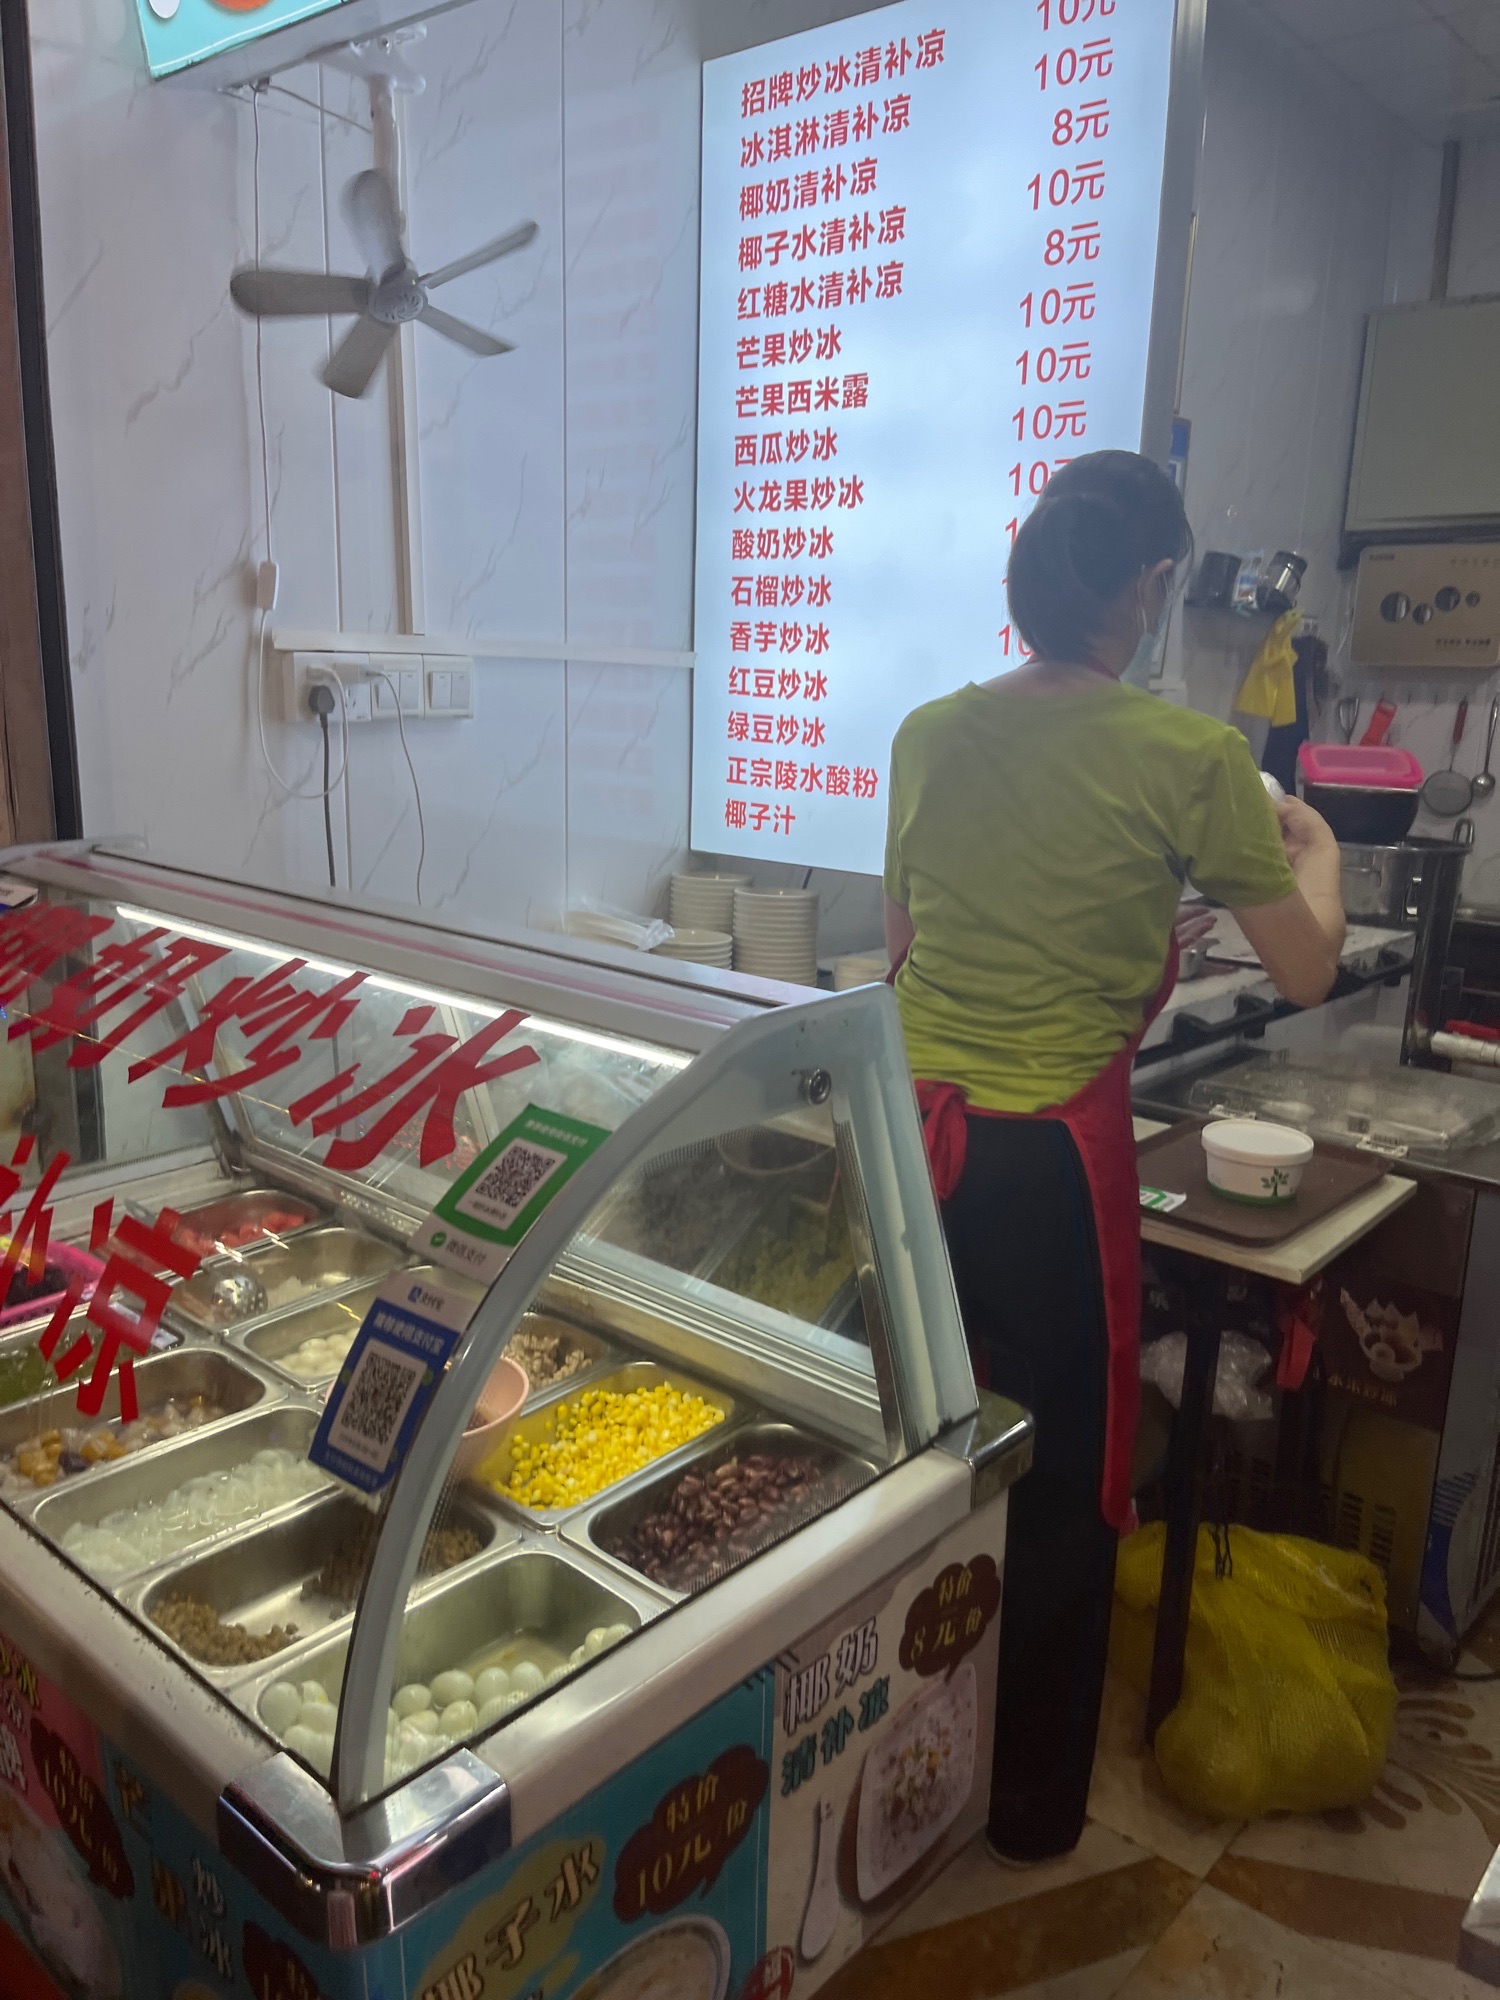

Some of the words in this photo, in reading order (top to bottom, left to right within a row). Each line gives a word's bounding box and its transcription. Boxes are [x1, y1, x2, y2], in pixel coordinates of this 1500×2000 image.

[740, 28, 945, 118] 招牌炒冰清补凉
[1033, 37, 1113, 90] 10元
[739, 92, 911, 167] 冰淇淋清补凉
[1050, 98, 1109, 146] 8元
[738, 156, 878, 220] 椰奶清补凉
[1027, 159, 1105, 210] 10元
[737, 204, 906, 271] 椰子水清补凉
[1042, 220, 1100, 266] 8元
[736, 260, 904, 320] 红糖水清补凉
[1019, 280, 1096, 327] 10元
[736, 324, 841, 370] 芒果炒冰
[1016, 340, 1091, 385] 10元
[734, 372, 869, 419] 芒果西米露
[1012, 399, 1087, 441] 10元
[734, 426, 838, 466] 西瓜炒冰
[732, 475, 864, 513] 火龙果炒冰
[730, 525, 833, 560] 酸奶炒冰
[730, 574, 831, 607] 石榴炒冰
[729, 620, 829, 655] 香芋炒冰
[728, 665, 827, 702] 红豆炒冰
[726, 710, 825, 748] 绿豆炒冰
[725, 755, 879, 799] 正宗陵水酸粉
[723, 798, 796, 835] 椰子汁
[782, 1614, 879, 1739] 椰奶
